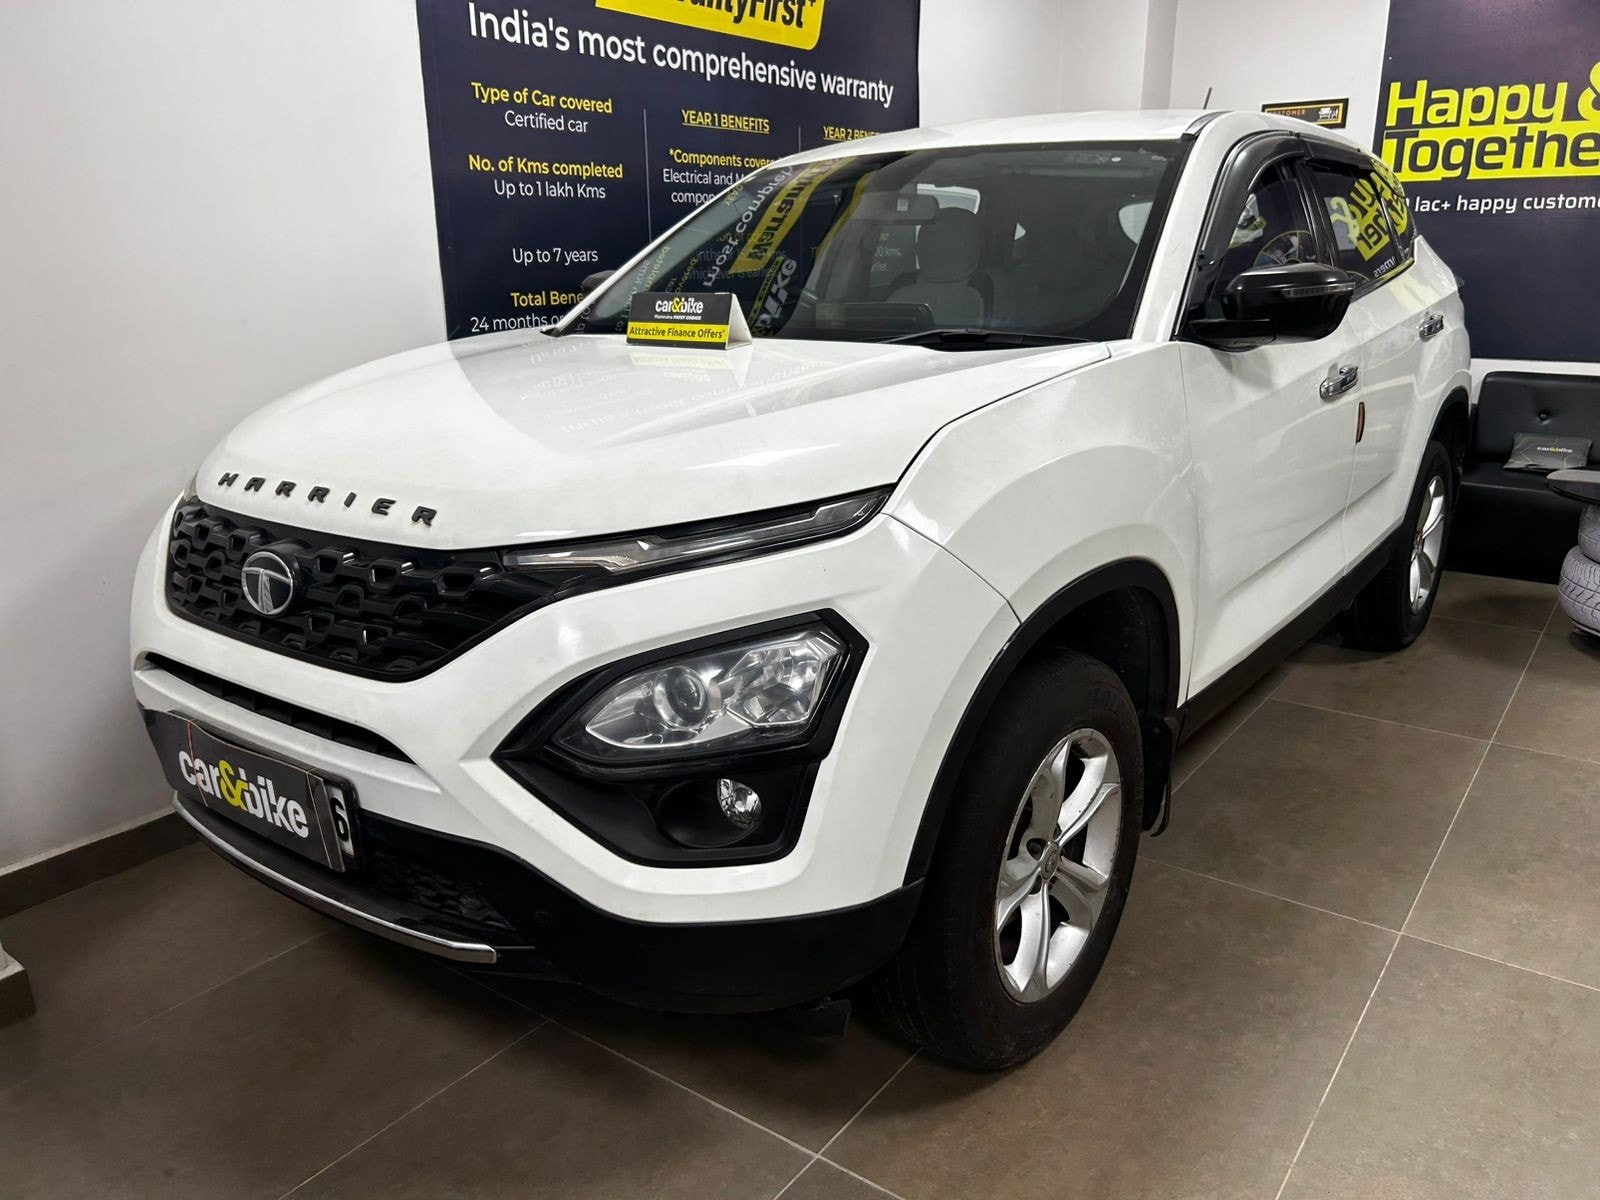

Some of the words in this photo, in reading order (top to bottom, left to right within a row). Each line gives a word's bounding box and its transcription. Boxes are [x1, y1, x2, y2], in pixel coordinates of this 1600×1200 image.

[468, 2, 570, 51] India's
[578, 29, 647, 64] most
[653, 44, 816, 90] comprehensive
[820, 73, 894, 108] warranty
[471, 82, 510, 104] Type
[513, 88, 528, 104] of
[531, 90, 556, 107] Car
[559, 96, 613, 113] covered
[1386, 79, 1568, 127] Happy
[504, 110, 564, 131] Certified
[567, 119, 588, 132] car
[681, 109, 712, 126] YEAR
[713, 113, 718, 126] 1
[720, 114, 770, 132] BENEFITS
[823, 126, 846, 140] YEAR
[846, 129, 853, 140] 2
[468, 154, 495, 171] No.
[498, 156, 513, 172] of
[517, 158, 549, 174] Kms
[552, 162, 623, 179] completed
[662, 168, 712, 185] Electrical
[713, 172, 733, 185] and
[494, 179, 516, 199] Up
[519, 181, 534, 196] to
[536, 181, 542, 196] 1
[545, 181, 573, 197] lakh
[577, 183, 606, 199] Kms
[1414, 196, 1451, 212] lac+
[1456, 195, 1518, 214] happy
[512, 248, 533, 266] Up
[536, 249, 550, 263] to
[553, 248, 562, 262] 7
[564, 249, 598, 265] years
[511, 291, 546, 307] Total
[550, 291, 586, 305] Bene
[655, 297, 704, 314] car&bike
[470, 316, 489, 333] 24
[493, 313, 547, 331] months
[629, 326, 666, 336] Attractive
[667, 328, 696, 337] Finance
[218, 472, 438, 527] HARRIER
[178, 751, 309, 838] car&bike
[329, 797, 349, 842] 6
